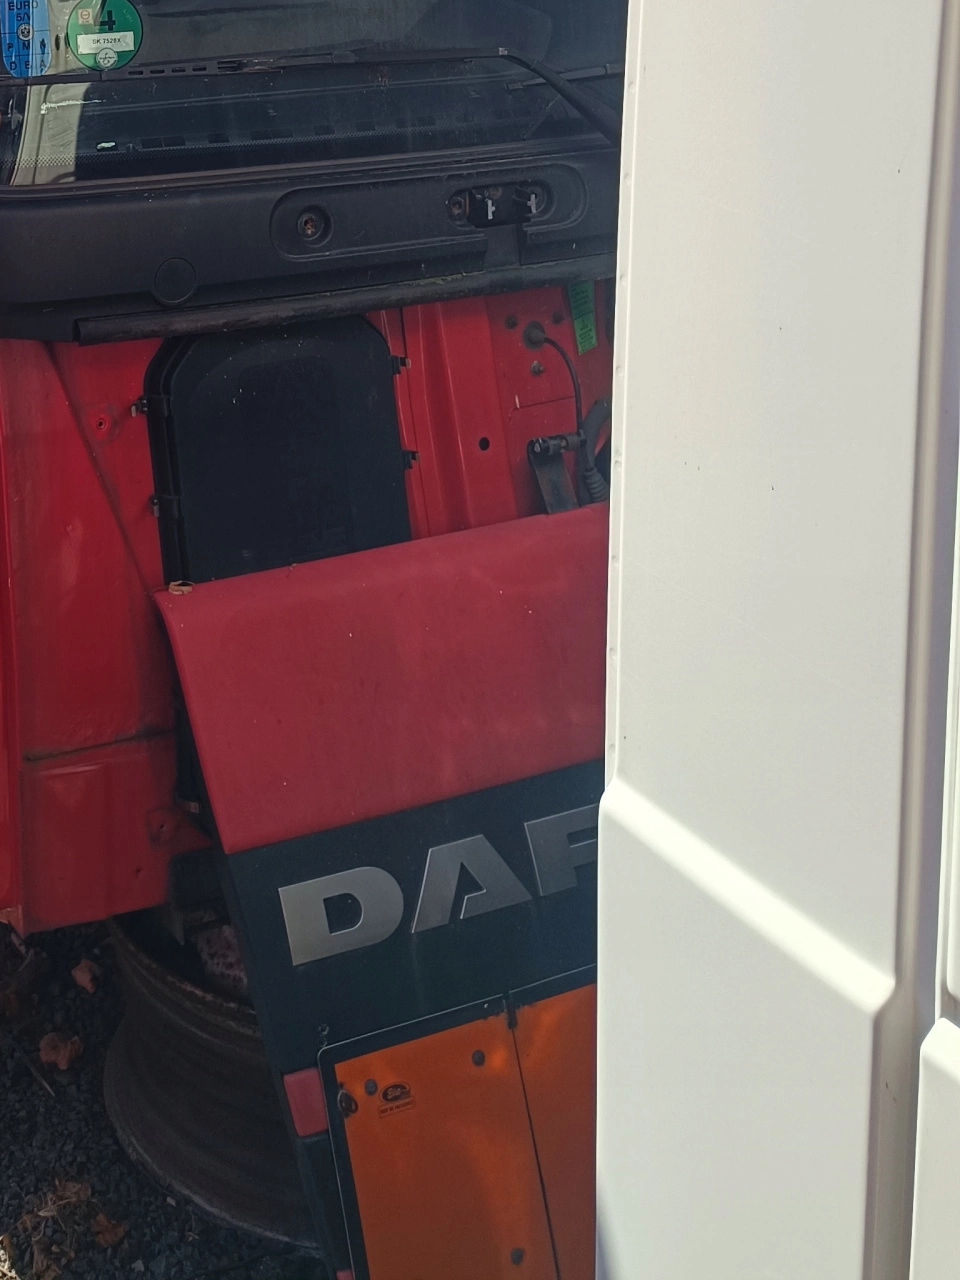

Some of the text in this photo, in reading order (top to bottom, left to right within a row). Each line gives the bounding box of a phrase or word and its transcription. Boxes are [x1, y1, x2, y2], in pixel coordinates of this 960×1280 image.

[8, 1, 39, 11] EURO
[22, 41, 31, 51] M
[10, 61, 17, 71] D
[278, 804, 598, 966] DAF
